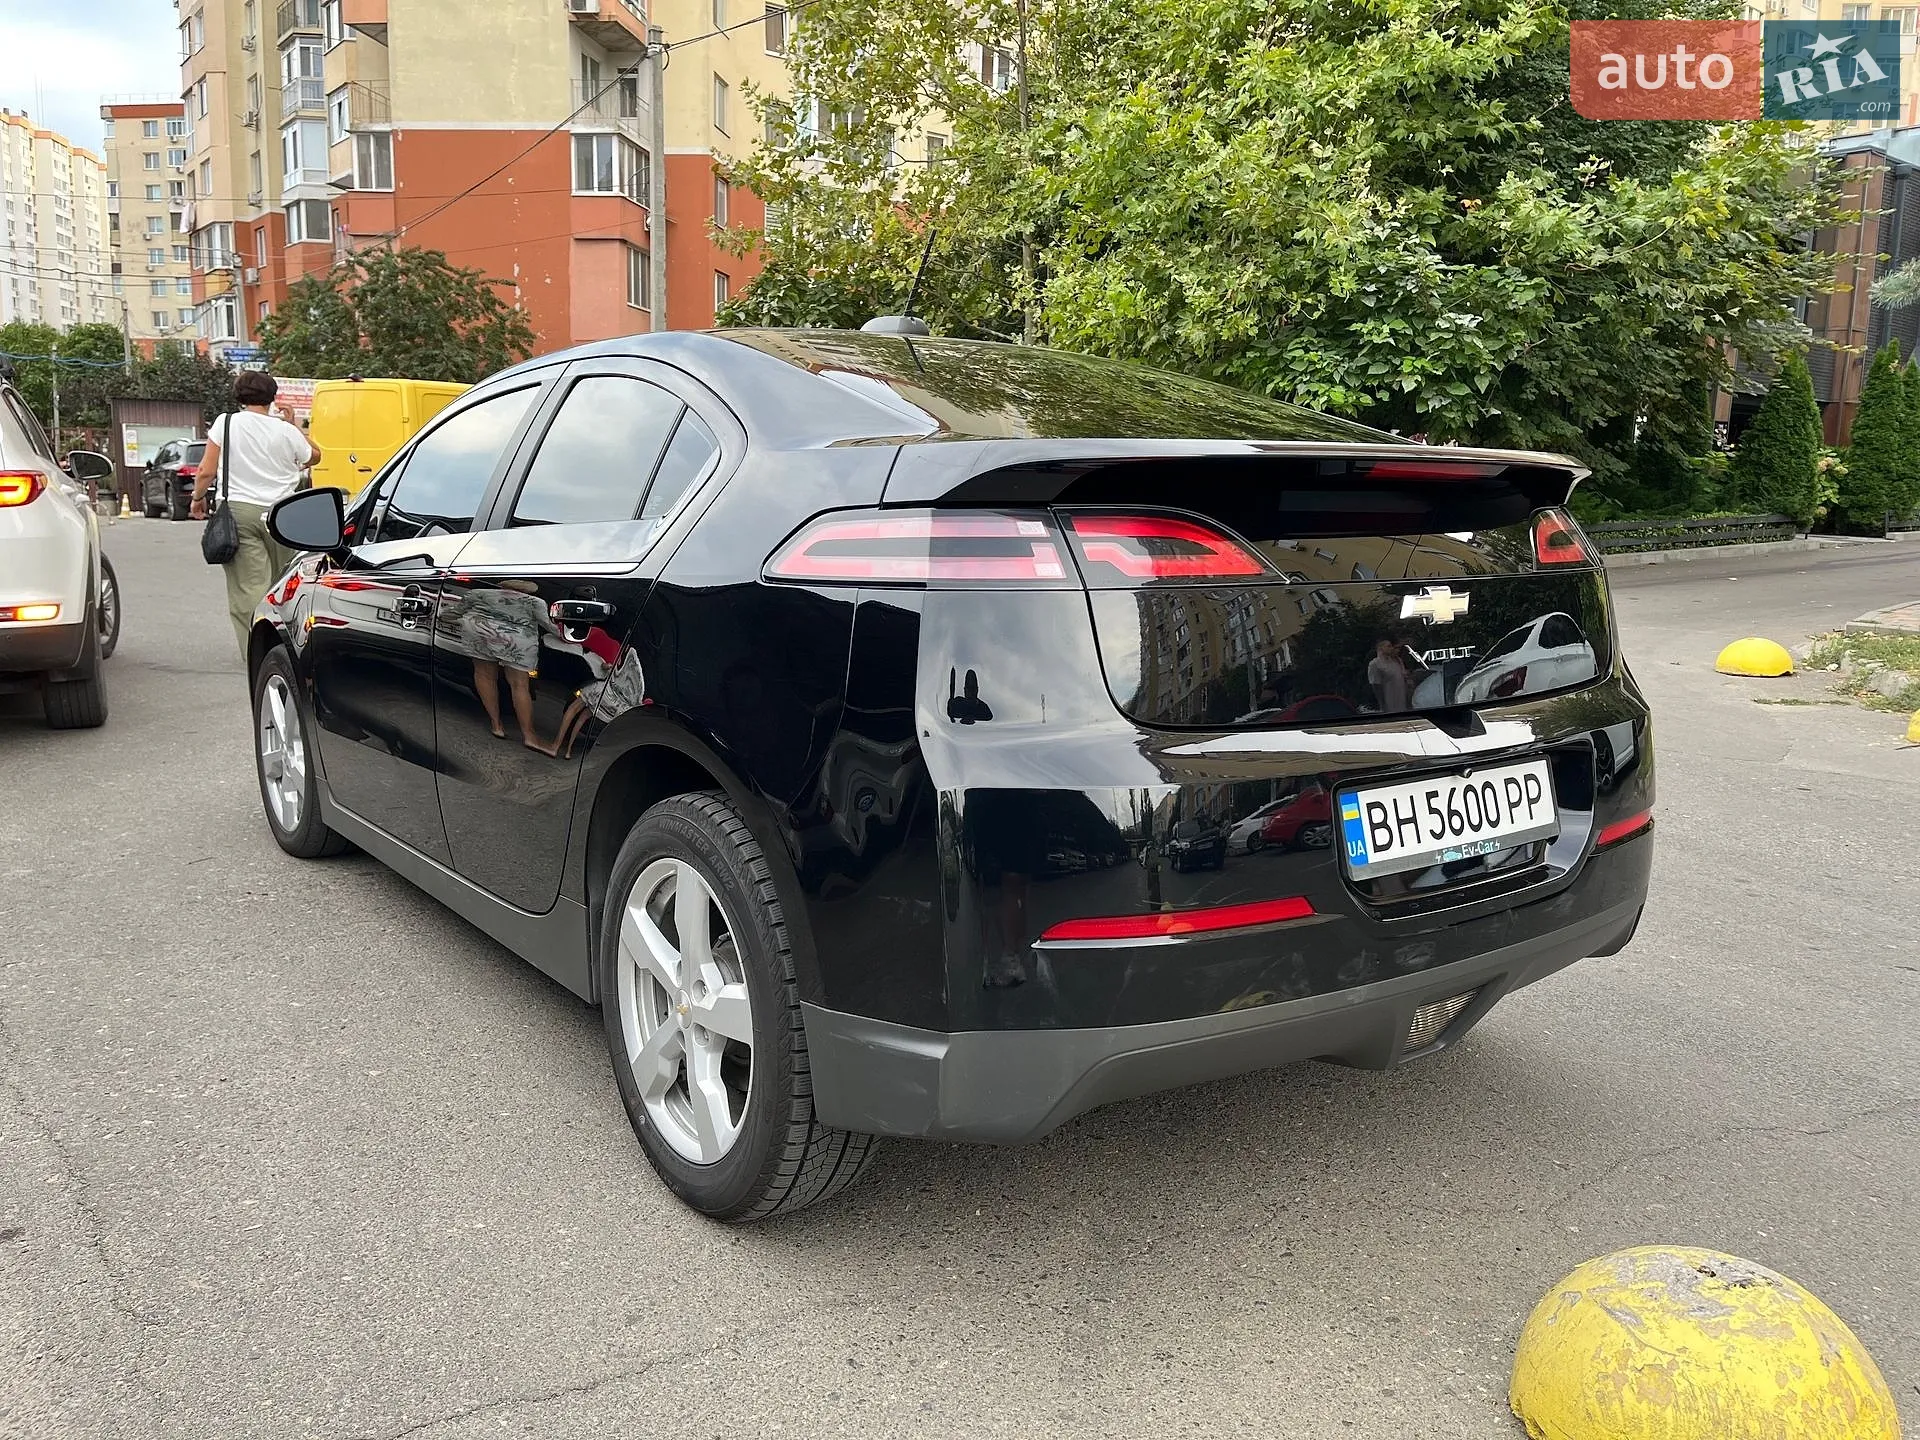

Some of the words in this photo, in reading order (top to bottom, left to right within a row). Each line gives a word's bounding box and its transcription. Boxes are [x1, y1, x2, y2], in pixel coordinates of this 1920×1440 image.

[1404, 644, 1476, 670] VOLT
[1366, 795, 1422, 854] BH
[1425, 780, 1501, 841] 5600
[1504, 773, 1541, 825] PP
[1347, 841, 1366, 858] UA
